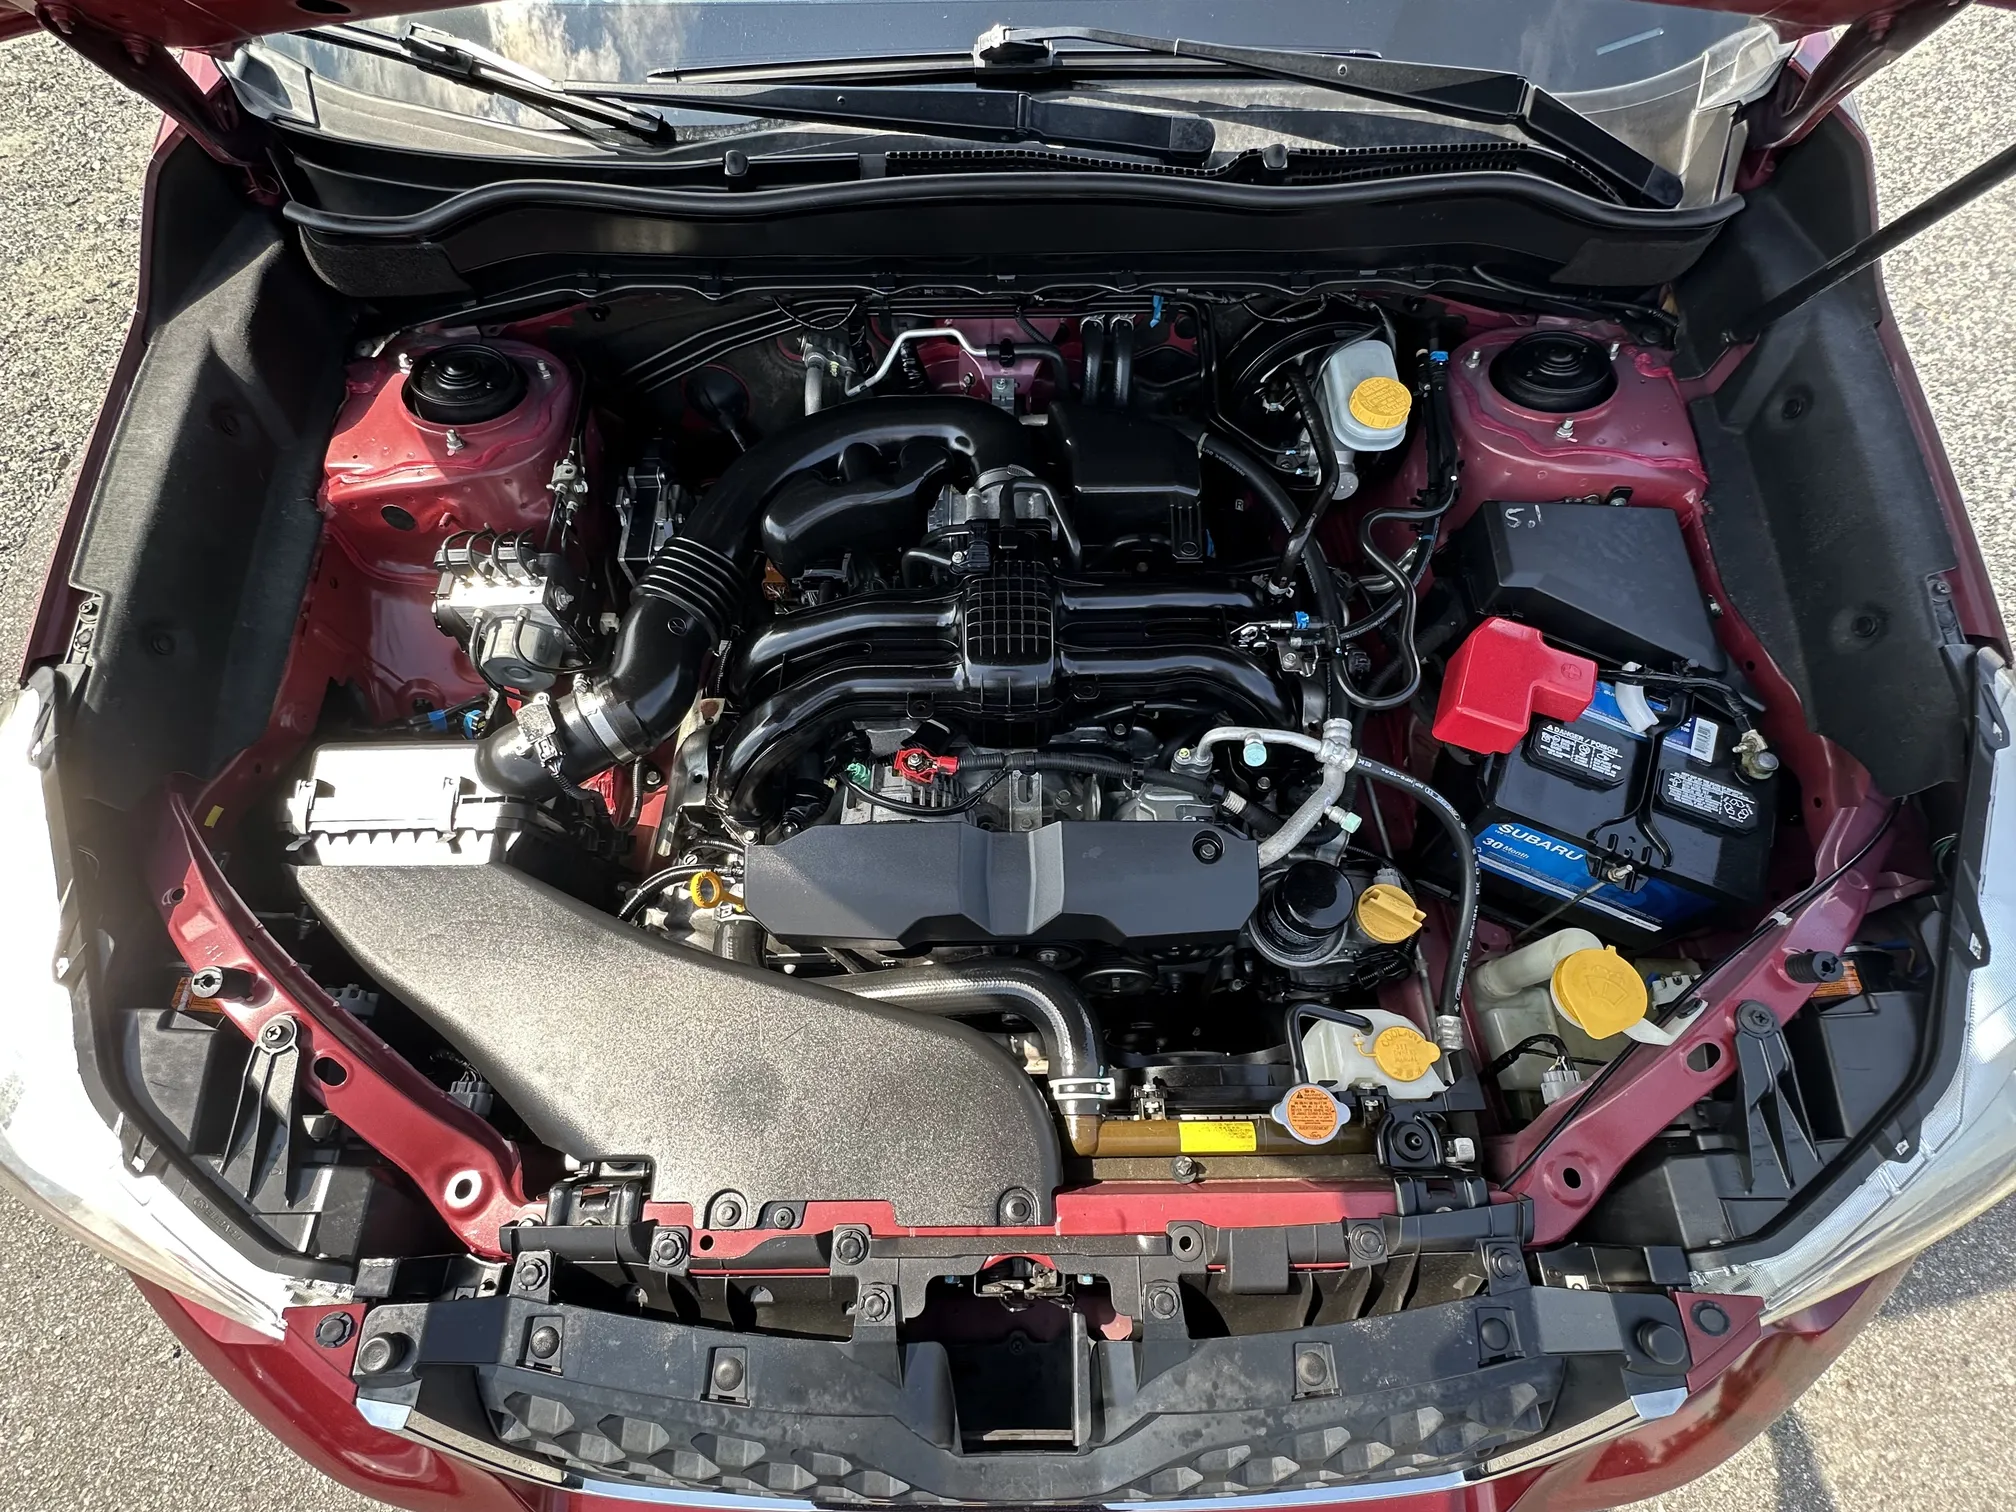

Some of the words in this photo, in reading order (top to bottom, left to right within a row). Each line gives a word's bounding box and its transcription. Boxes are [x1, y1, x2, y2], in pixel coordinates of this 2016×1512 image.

[1553, 724, 1585, 742] DANGER
[1590, 739, 1619, 755] POISON
[1482, 837, 1505, 850] 30
[1502, 845, 1530, 860] Month
[1498, 823, 1585, 861] SUBARU
